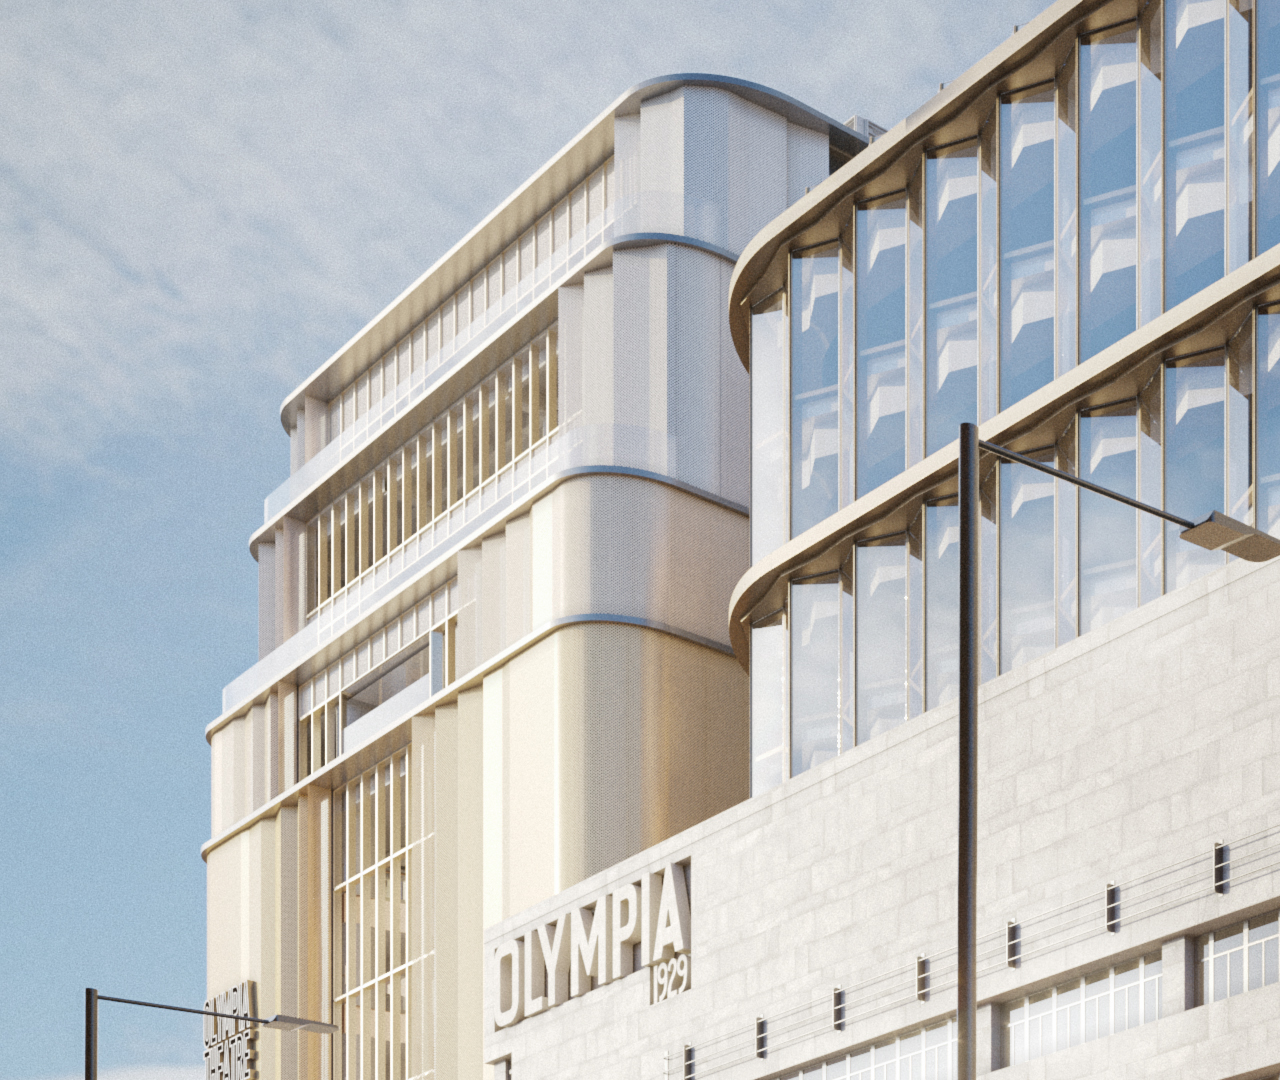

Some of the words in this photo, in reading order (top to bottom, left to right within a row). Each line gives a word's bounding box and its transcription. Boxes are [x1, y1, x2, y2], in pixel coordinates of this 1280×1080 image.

[494, 860, 690, 1028] OLYMPIA
[652, 953, 688, 1004] 1929
[203, 980, 251, 1049] OLYMPIA
